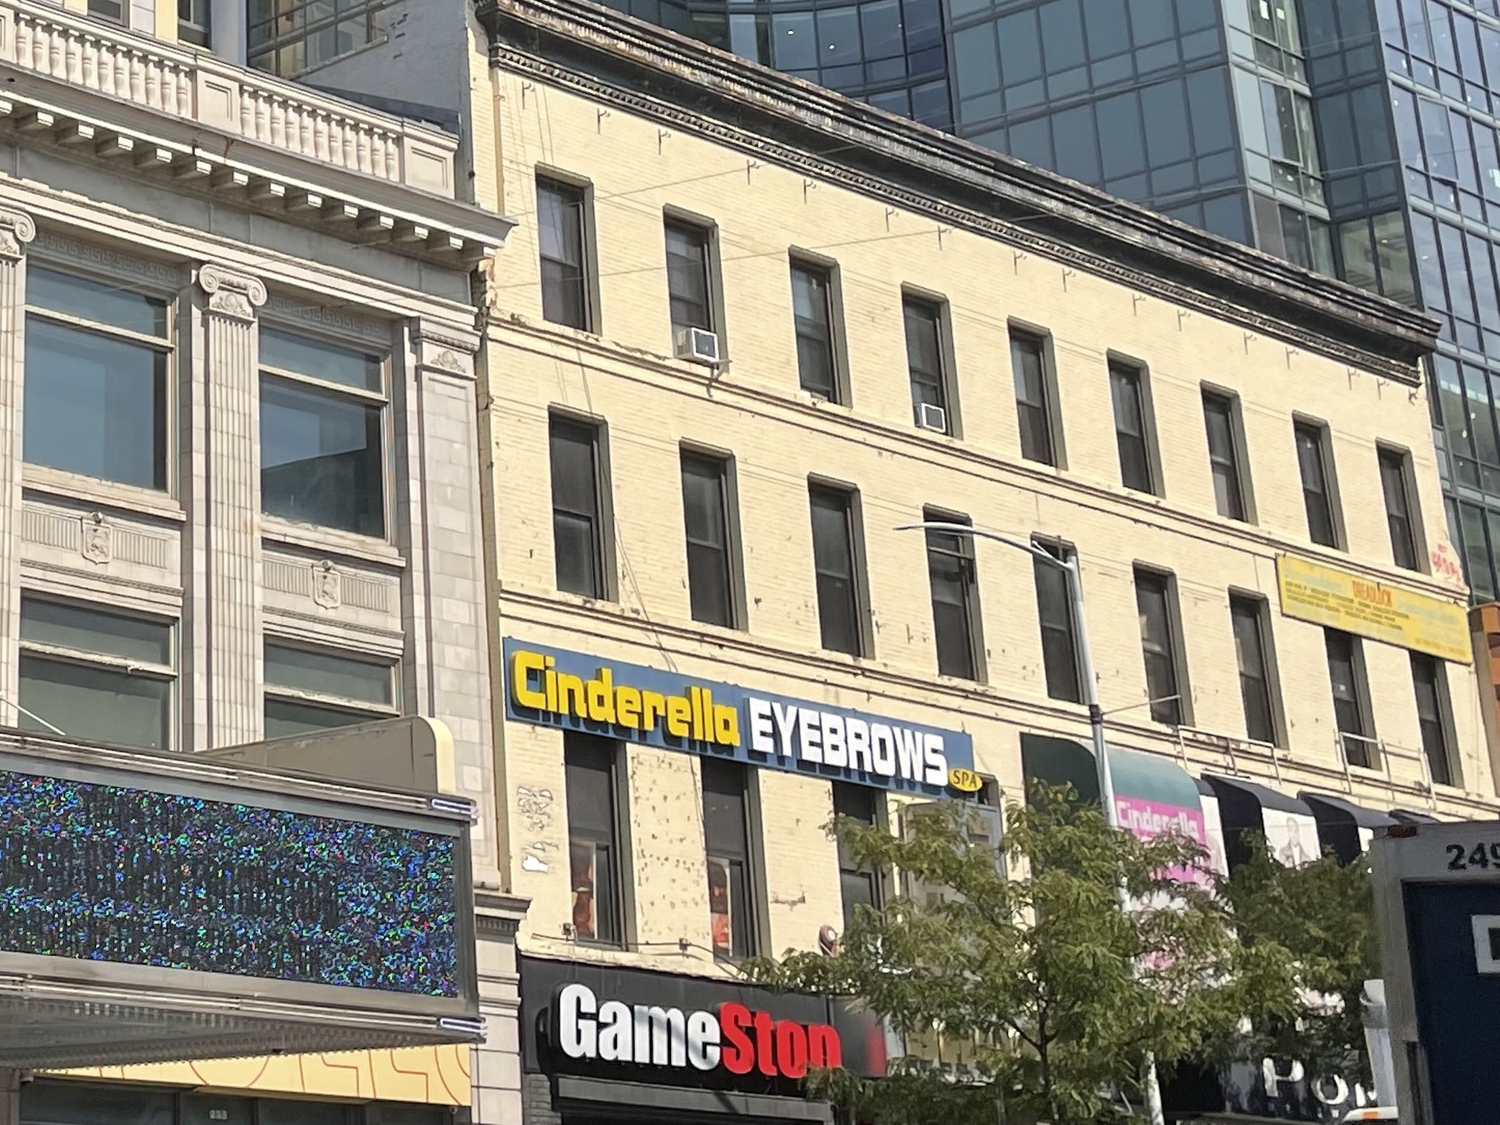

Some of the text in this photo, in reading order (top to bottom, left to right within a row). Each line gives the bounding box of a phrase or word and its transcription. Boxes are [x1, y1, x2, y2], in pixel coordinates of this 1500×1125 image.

[511, 650, 977, 788] Cinderella EYEBROWS SPA
[1116, 800, 1199, 838] Cinderella
